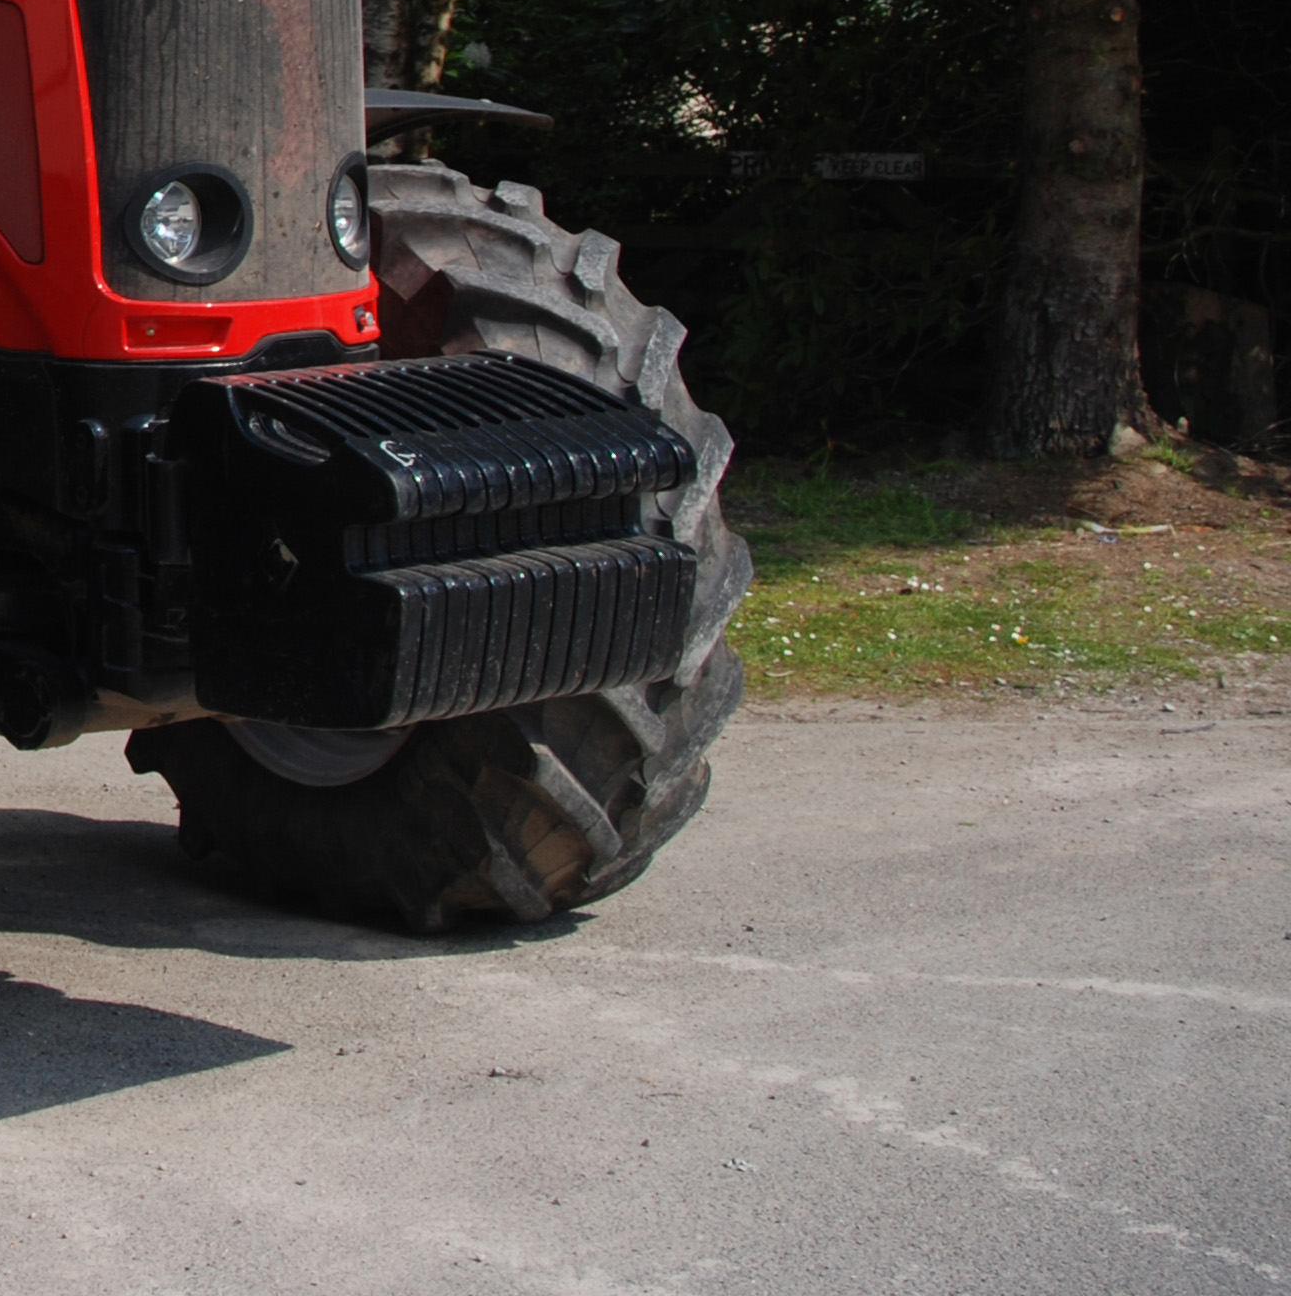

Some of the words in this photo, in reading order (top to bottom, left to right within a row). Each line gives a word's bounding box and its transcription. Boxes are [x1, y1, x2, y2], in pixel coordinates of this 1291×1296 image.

[729, 155, 823, 177] PRIVE
[831, 159, 870, 176] KEEP
[874, 160, 922, 176] CLEAR
